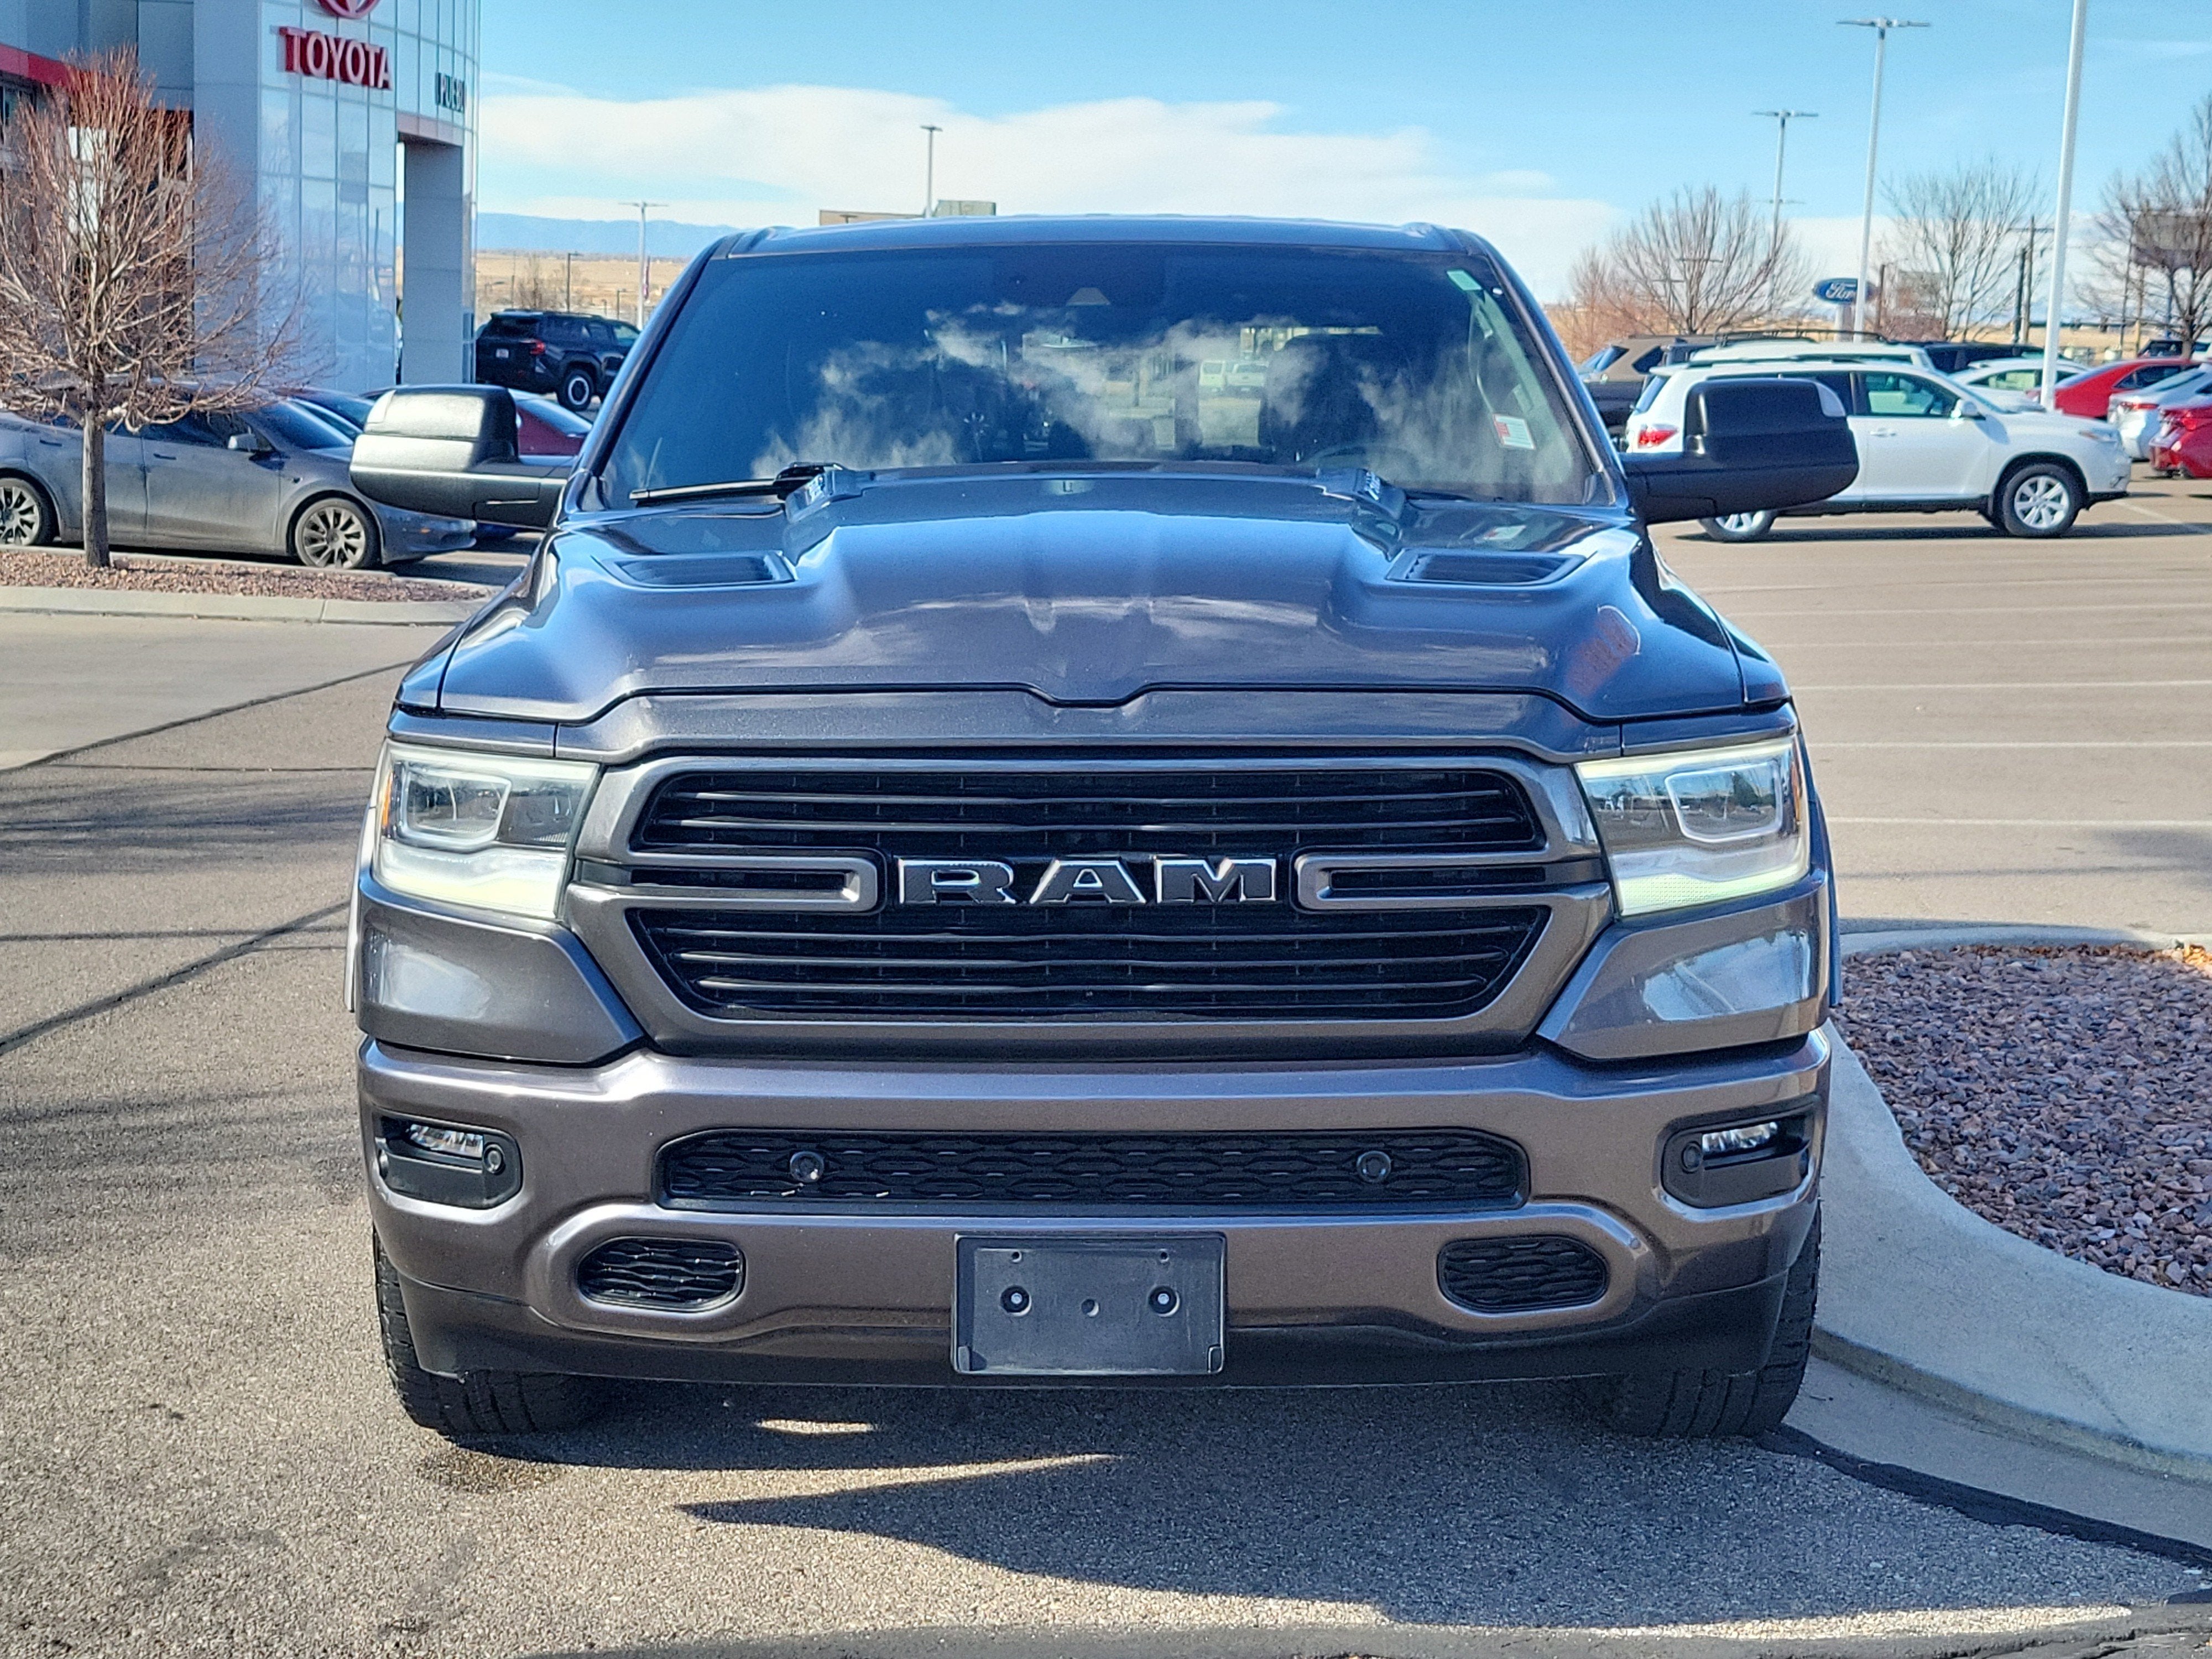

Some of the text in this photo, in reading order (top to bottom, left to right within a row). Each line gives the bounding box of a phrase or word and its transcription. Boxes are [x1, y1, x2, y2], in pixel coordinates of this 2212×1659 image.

[279, 27, 392, 90] TOYOTA
[1825, 283, 1857, 299] For
[897, 856, 1277, 905] RAM
